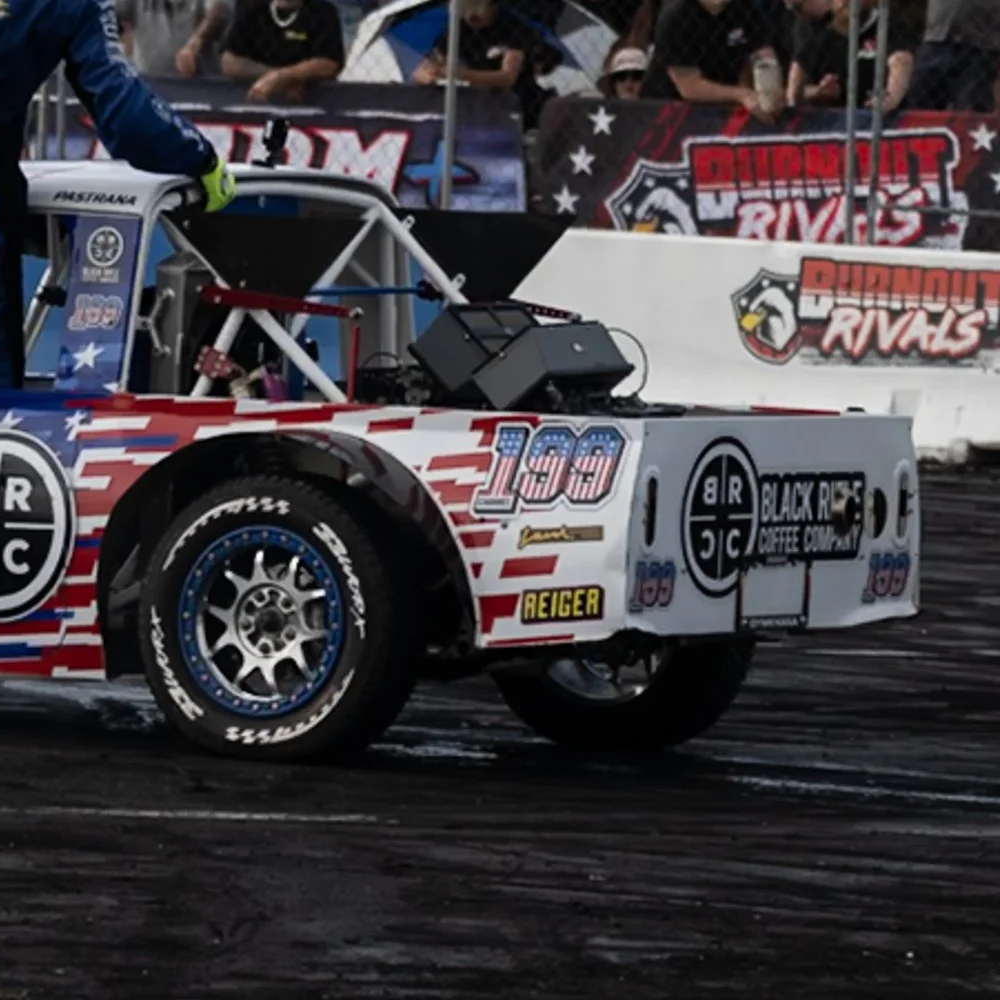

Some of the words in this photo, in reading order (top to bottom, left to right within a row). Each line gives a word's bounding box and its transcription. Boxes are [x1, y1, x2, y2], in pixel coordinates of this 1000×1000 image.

[53, 191, 137, 205] PASTRANA
[819, 306, 988, 362] RIVALS
[474, 425, 627, 515] 199
[761, 481, 815, 523] BLACK
[817, 479, 862, 522] RIE
[759, 526, 800, 553] COFFEE
[522, 588, 600, 620] REIGER
